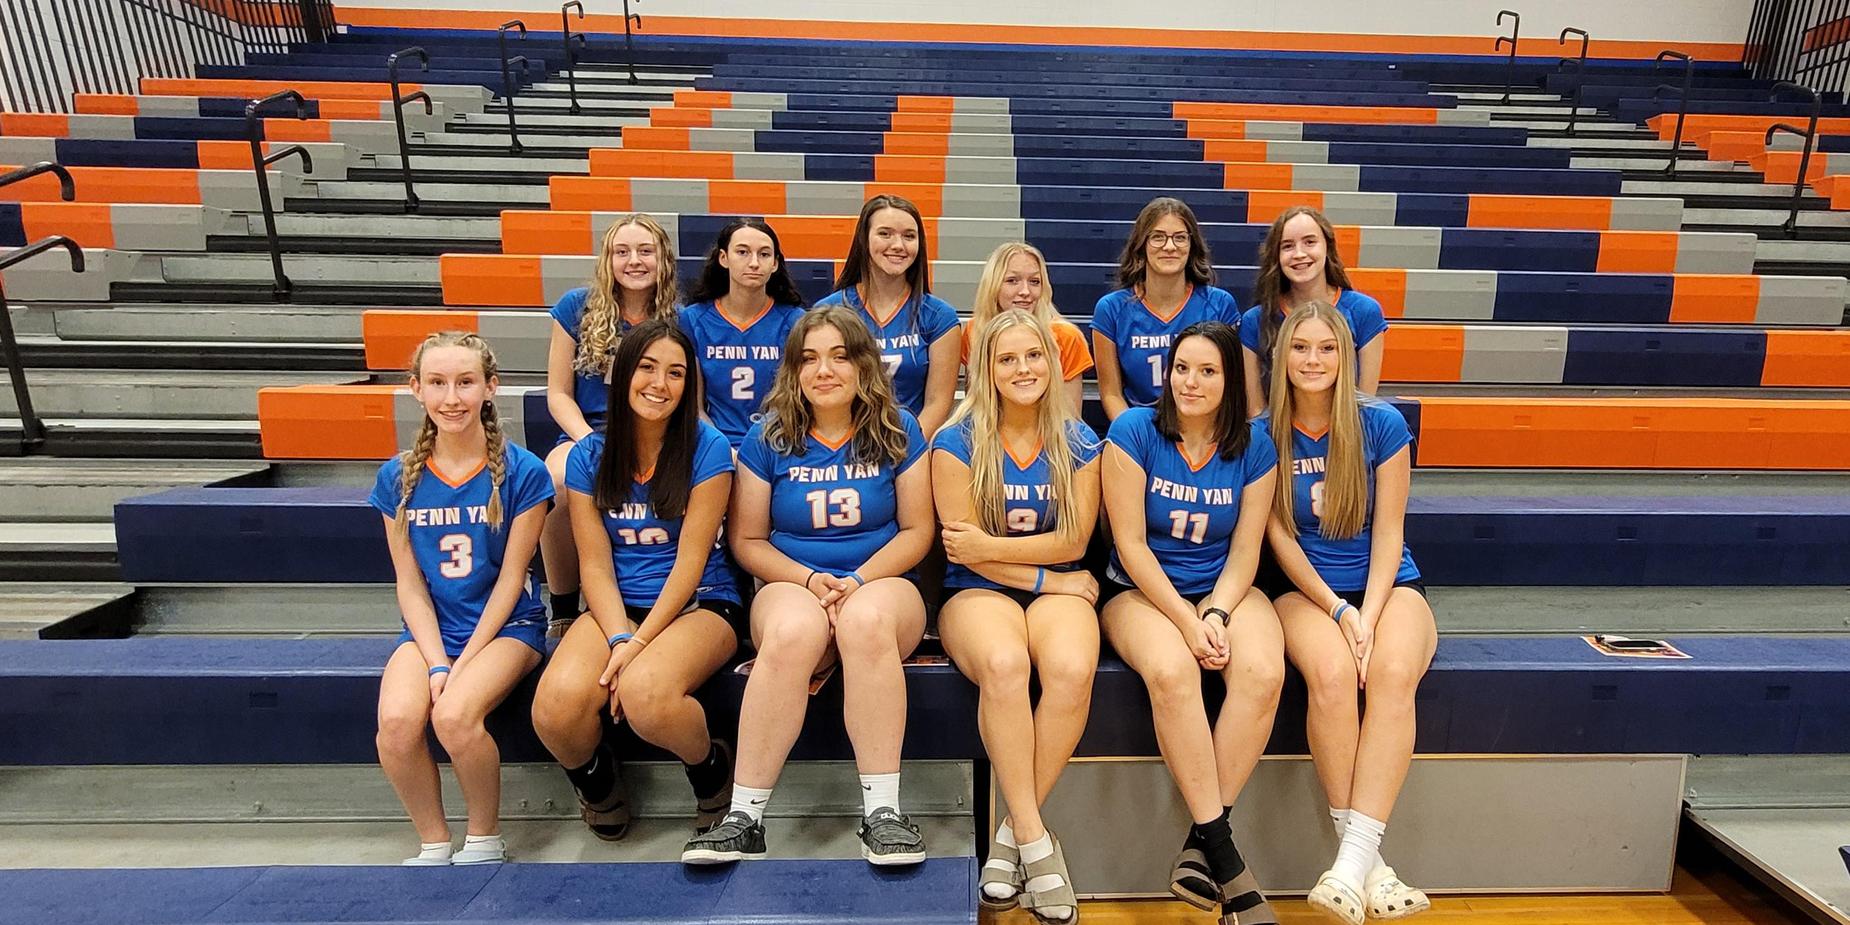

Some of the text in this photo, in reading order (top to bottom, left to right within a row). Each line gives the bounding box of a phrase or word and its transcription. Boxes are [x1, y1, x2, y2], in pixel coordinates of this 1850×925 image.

[890, 334, 919, 349] YAN
[1131, 334, 1170, 349] PENN
[706, 345, 779, 360] PENN YAN
[731, 366, 754, 400] 2
[789, 461, 880, 482] PENN YAN
[1292, 457, 1325, 474] ENN
[1151, 476, 1233, 505] PENN YAN
[405, 505, 504, 526] PENN YA
[805, 487, 862, 529] 13
[1169, 509, 1210, 545] 11
[439, 533, 473, 578] 3
